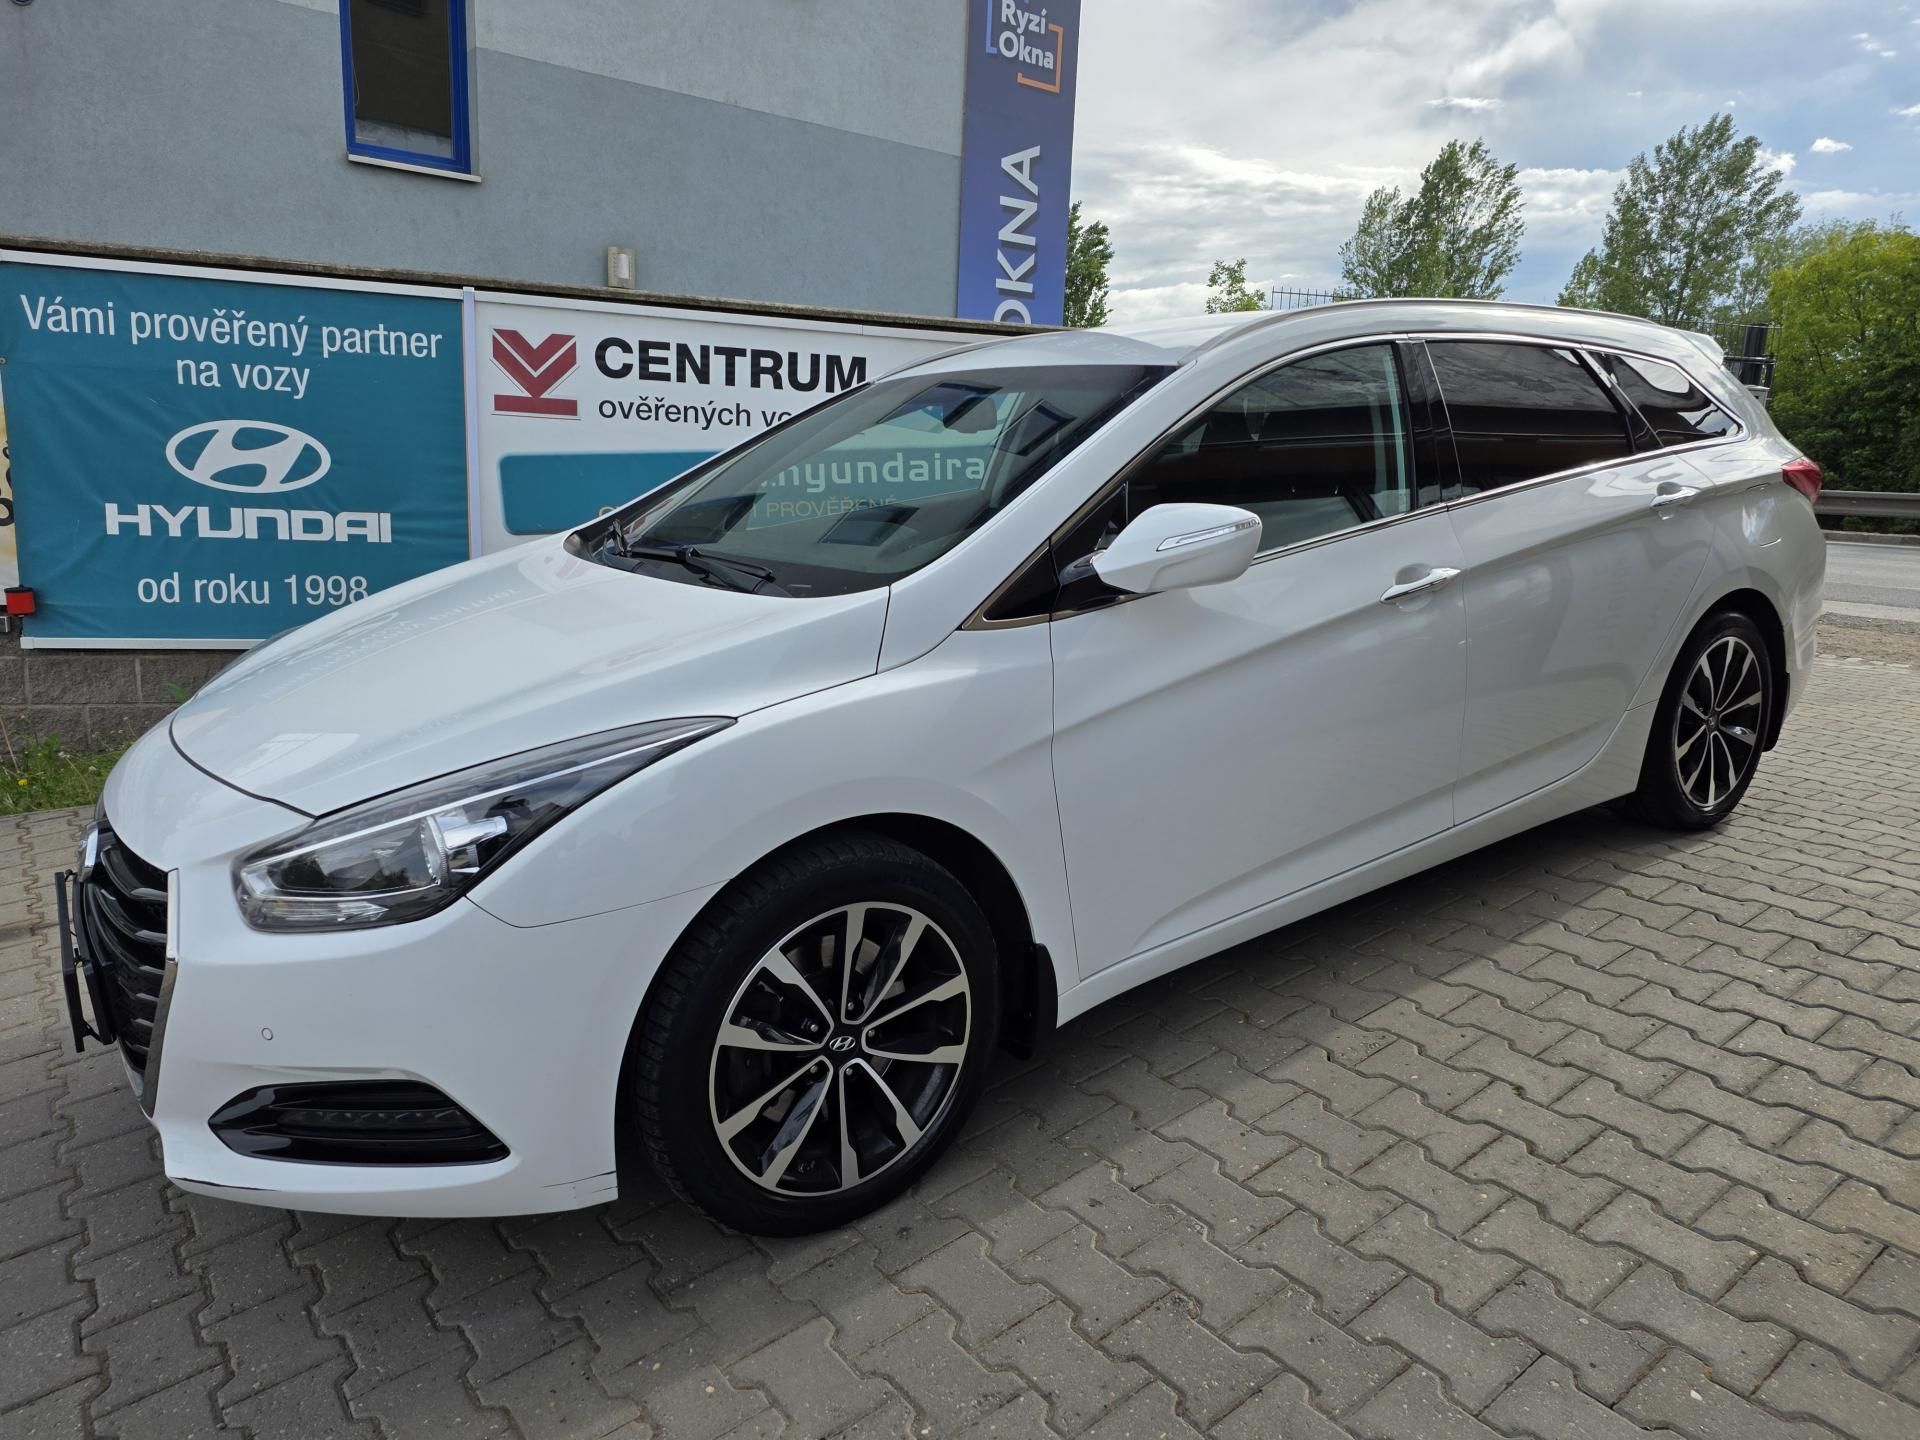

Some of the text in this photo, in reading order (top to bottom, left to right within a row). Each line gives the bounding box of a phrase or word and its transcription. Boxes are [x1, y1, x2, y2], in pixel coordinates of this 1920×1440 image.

[1001, 0, 1048, 34] Ryzí
[999, 31, 1054, 70] Okna
[20, 293, 443, 359] Vámi prověřený partner
[176, 358, 311, 400] na vozy
[594, 336, 867, 394] CENTRUM
[598, 395, 752, 430] ověřených
[104, 502, 393, 544] HYUNDAI
[138, 571, 370, 606] od roku 1998
